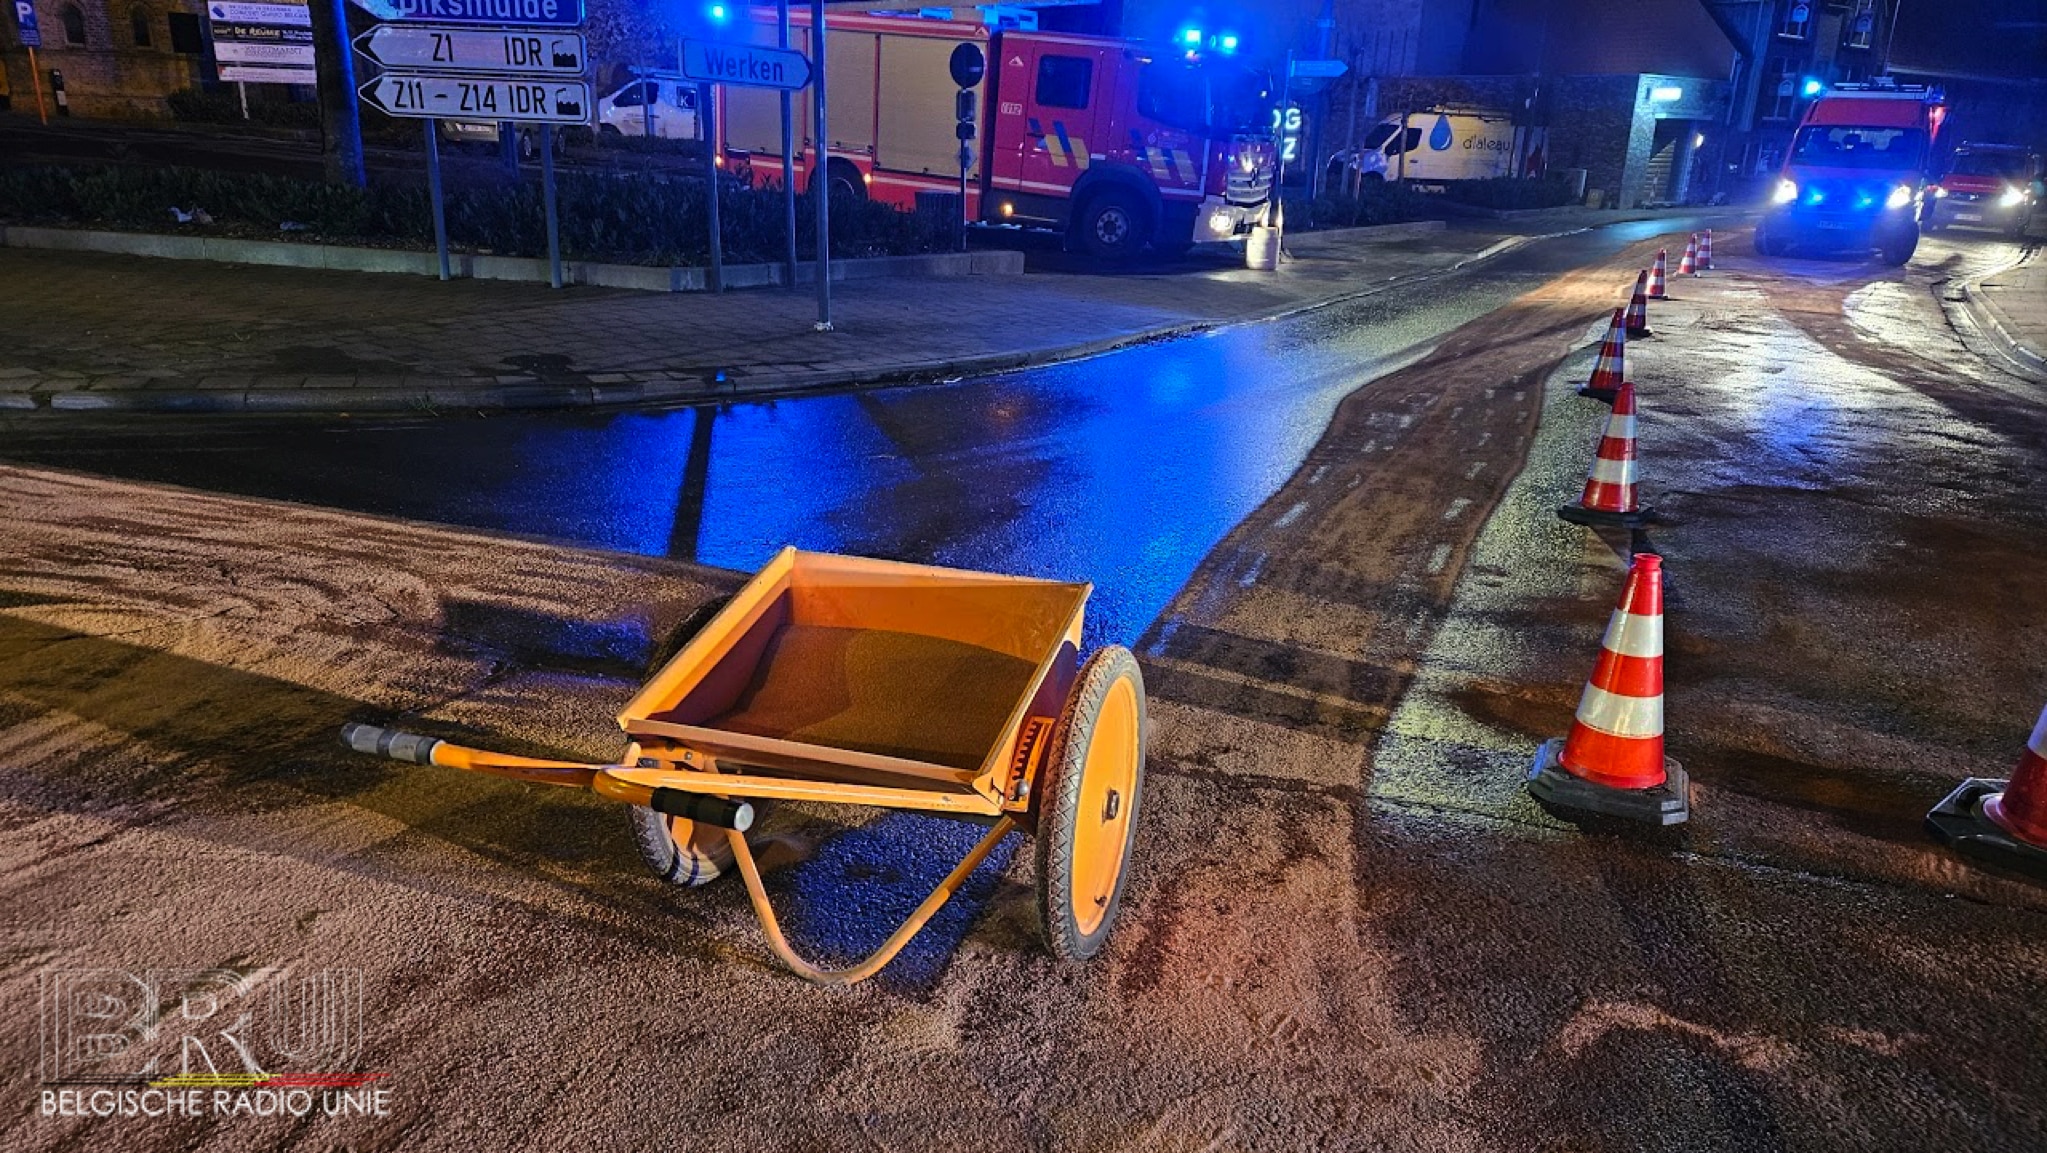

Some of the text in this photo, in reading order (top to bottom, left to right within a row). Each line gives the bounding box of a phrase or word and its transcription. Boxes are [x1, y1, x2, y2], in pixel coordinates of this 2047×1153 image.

[16, 1, 33, 23] P
[430, 33, 543, 66] Z1 IDR
[704, 47, 783, 82] Werken
[392, 80, 425, 110] Z11
[458, 83, 497, 113] Z14
[508, 85, 548, 114] IDR
